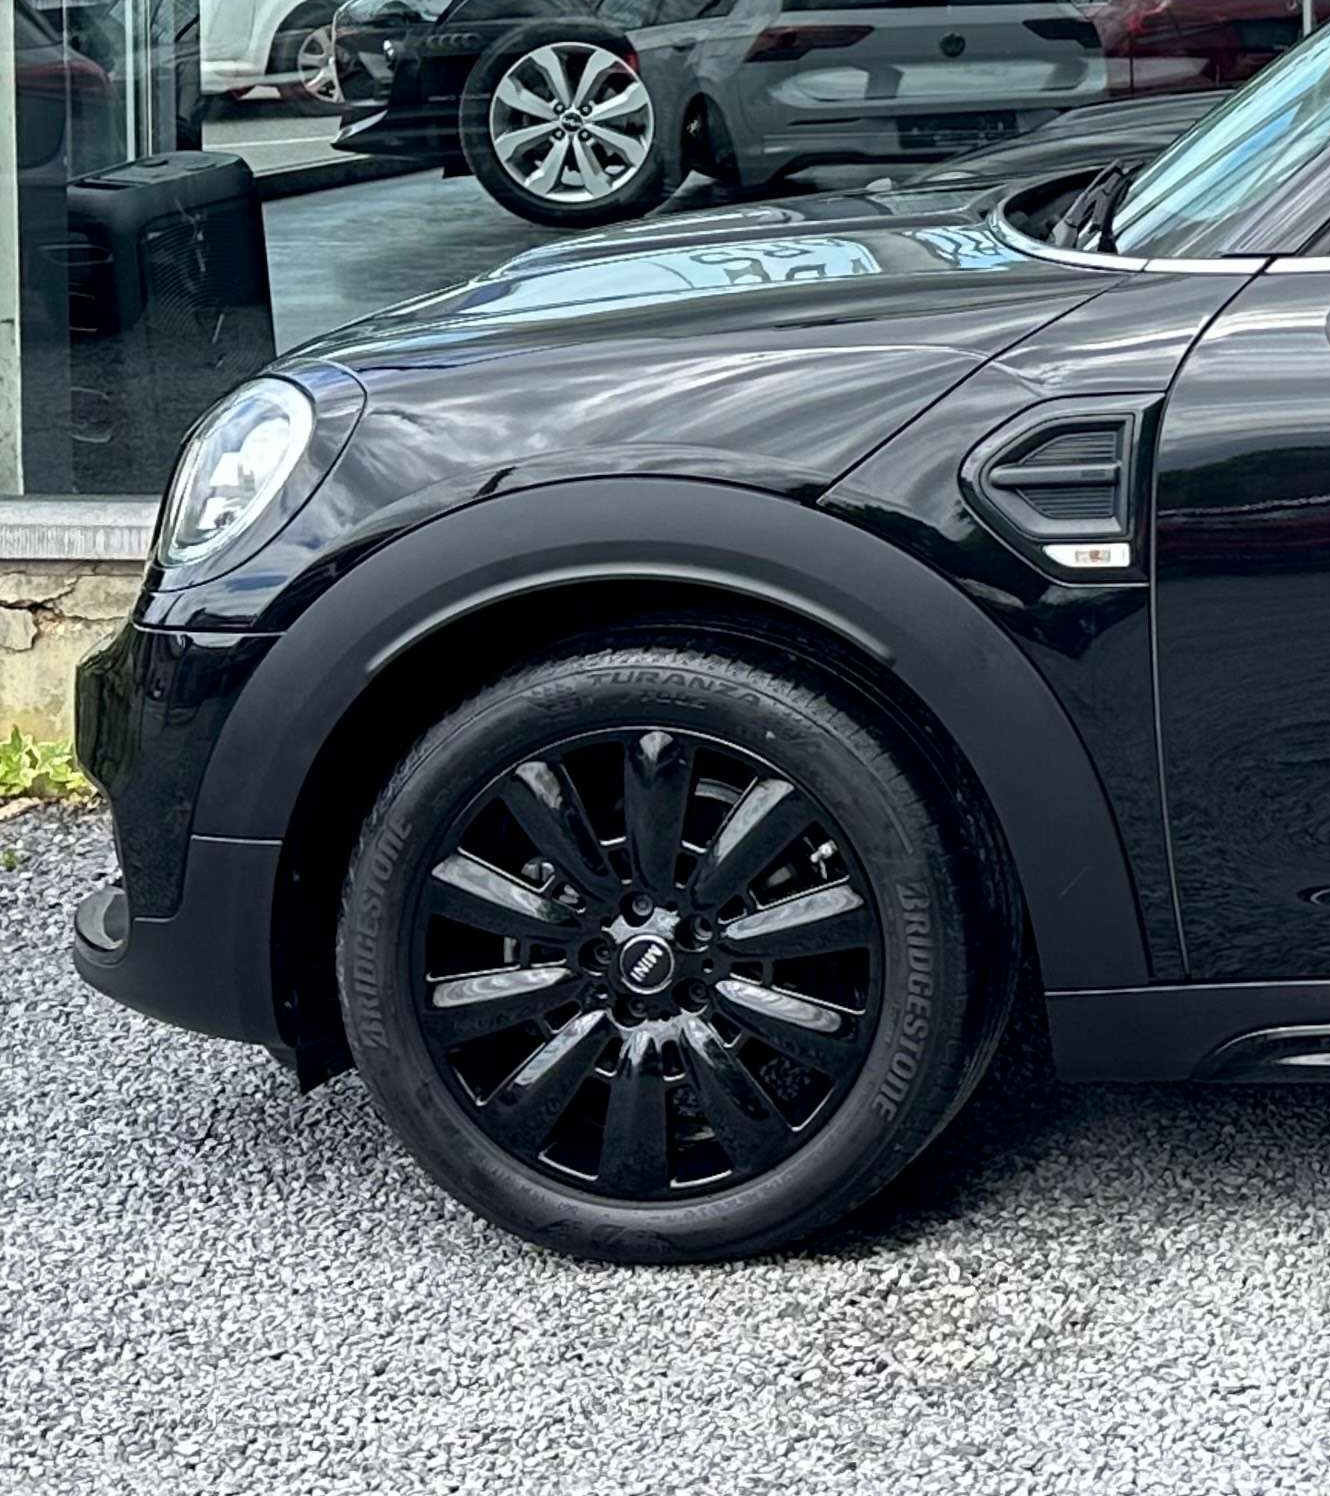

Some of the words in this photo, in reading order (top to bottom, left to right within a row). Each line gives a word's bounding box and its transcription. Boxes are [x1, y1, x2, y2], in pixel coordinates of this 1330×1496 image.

[586, 669, 762, 709] TURANZA
[353, 814, 413, 1050] BRIDGESTONE
[630, 944, 663, 982] MINI
[872, 880, 934, 1123] BRIDGESTONE
